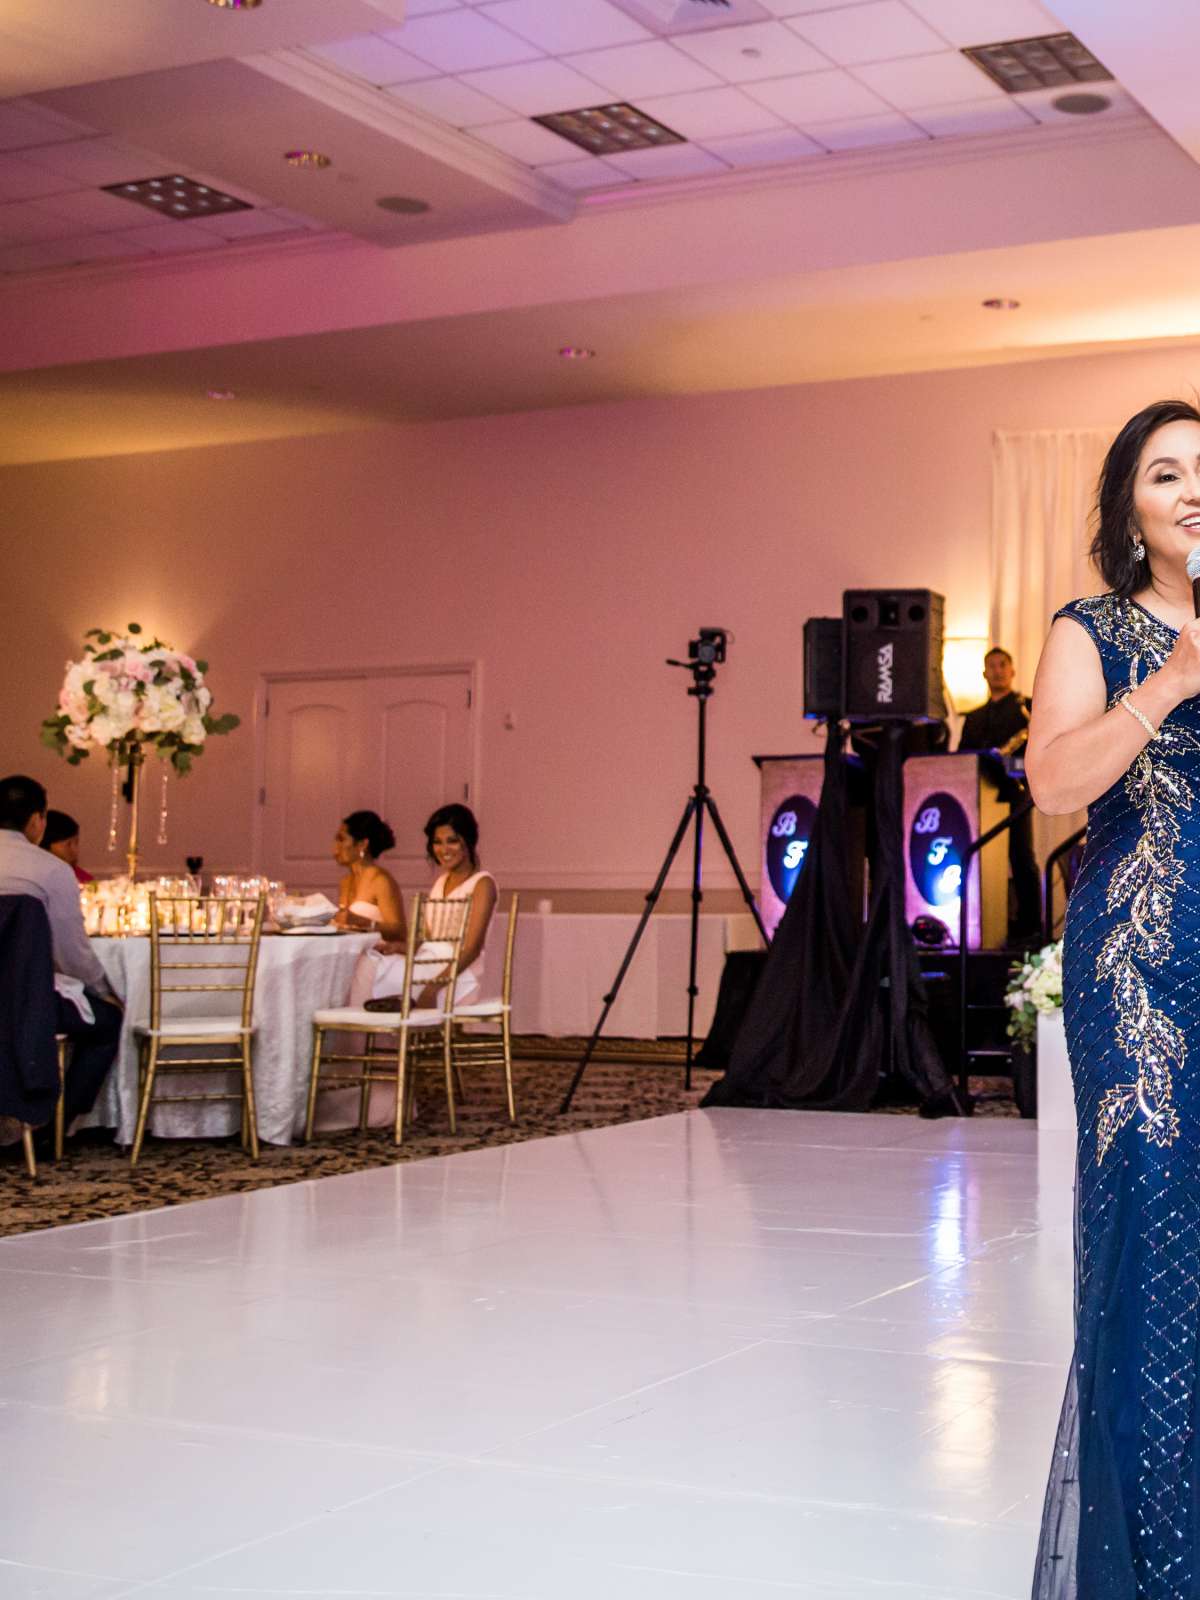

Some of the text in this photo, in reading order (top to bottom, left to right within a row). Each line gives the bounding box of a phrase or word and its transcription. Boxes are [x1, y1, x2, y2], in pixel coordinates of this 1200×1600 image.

[878, 643, 893, 703] RAMSA
[772, 811, 796, 836] B
[915, 807, 940, 832] B
[927, 836, 953, 866] F
